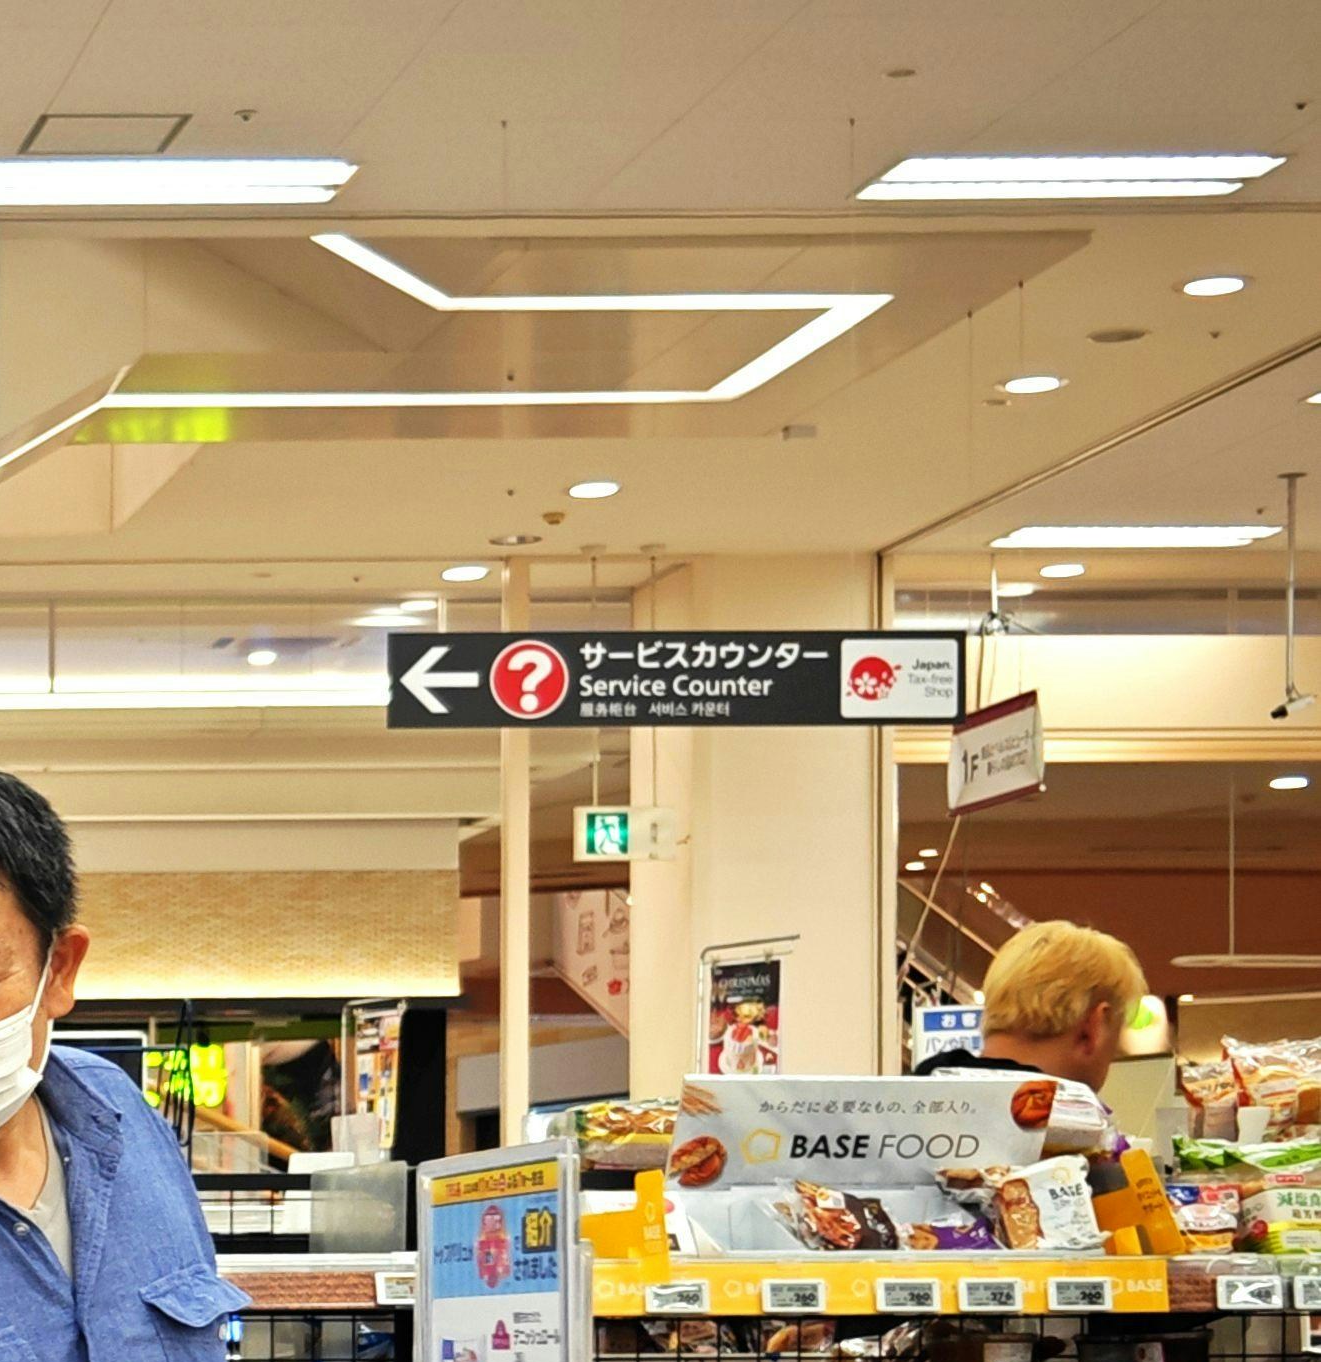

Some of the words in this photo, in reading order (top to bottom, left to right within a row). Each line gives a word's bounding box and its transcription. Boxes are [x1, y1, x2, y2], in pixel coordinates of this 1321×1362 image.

[578, 641, 830, 670] サービスカウンター
[578, 674, 666, 698] Service
[672, 675, 774, 698] Counter
[924, 687, 955, 700] Shop
[648, 702, 689, 717] 서비스
[692, 702, 731, 717] 카운터
[789, 1133, 871, 1161] BASE
[877, 1133, 980, 1161] FOOD
